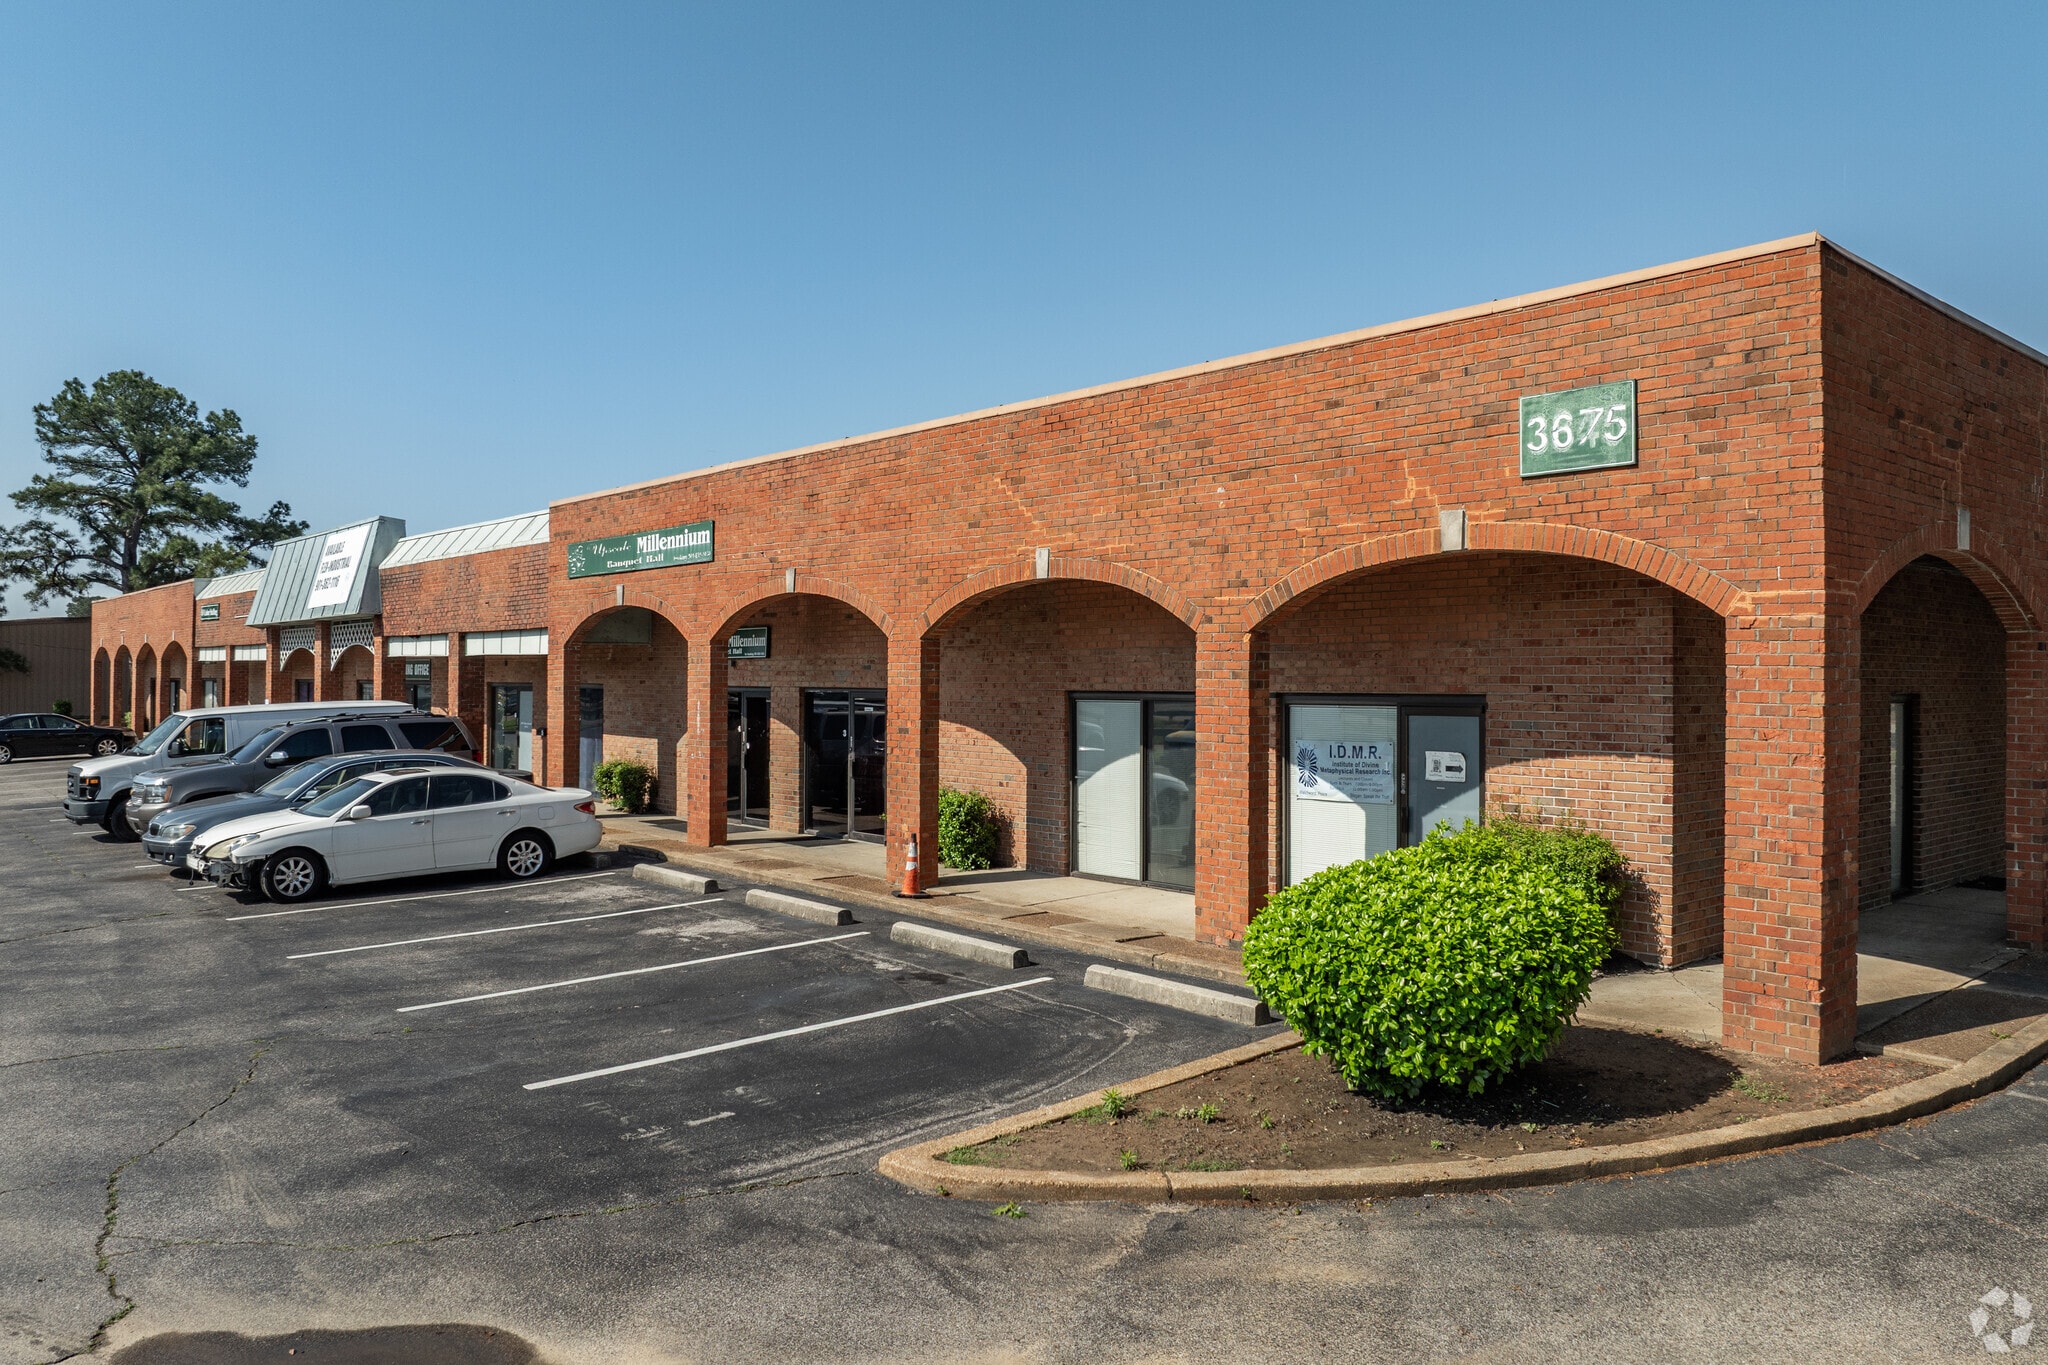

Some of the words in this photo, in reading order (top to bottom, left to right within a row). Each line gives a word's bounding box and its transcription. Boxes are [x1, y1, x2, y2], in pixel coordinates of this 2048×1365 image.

[1527, 404, 1628, 452] 3675
[636, 528, 711, 554] Millennium
[607, 558, 642, 569] Banquet
[646, 554, 664, 563] Hall
[415, 664, 430, 675] OFFICE
[1329, 744, 1382, 759] I.D.M.R.
[1320, 767, 1354, 775] Metaphysical
